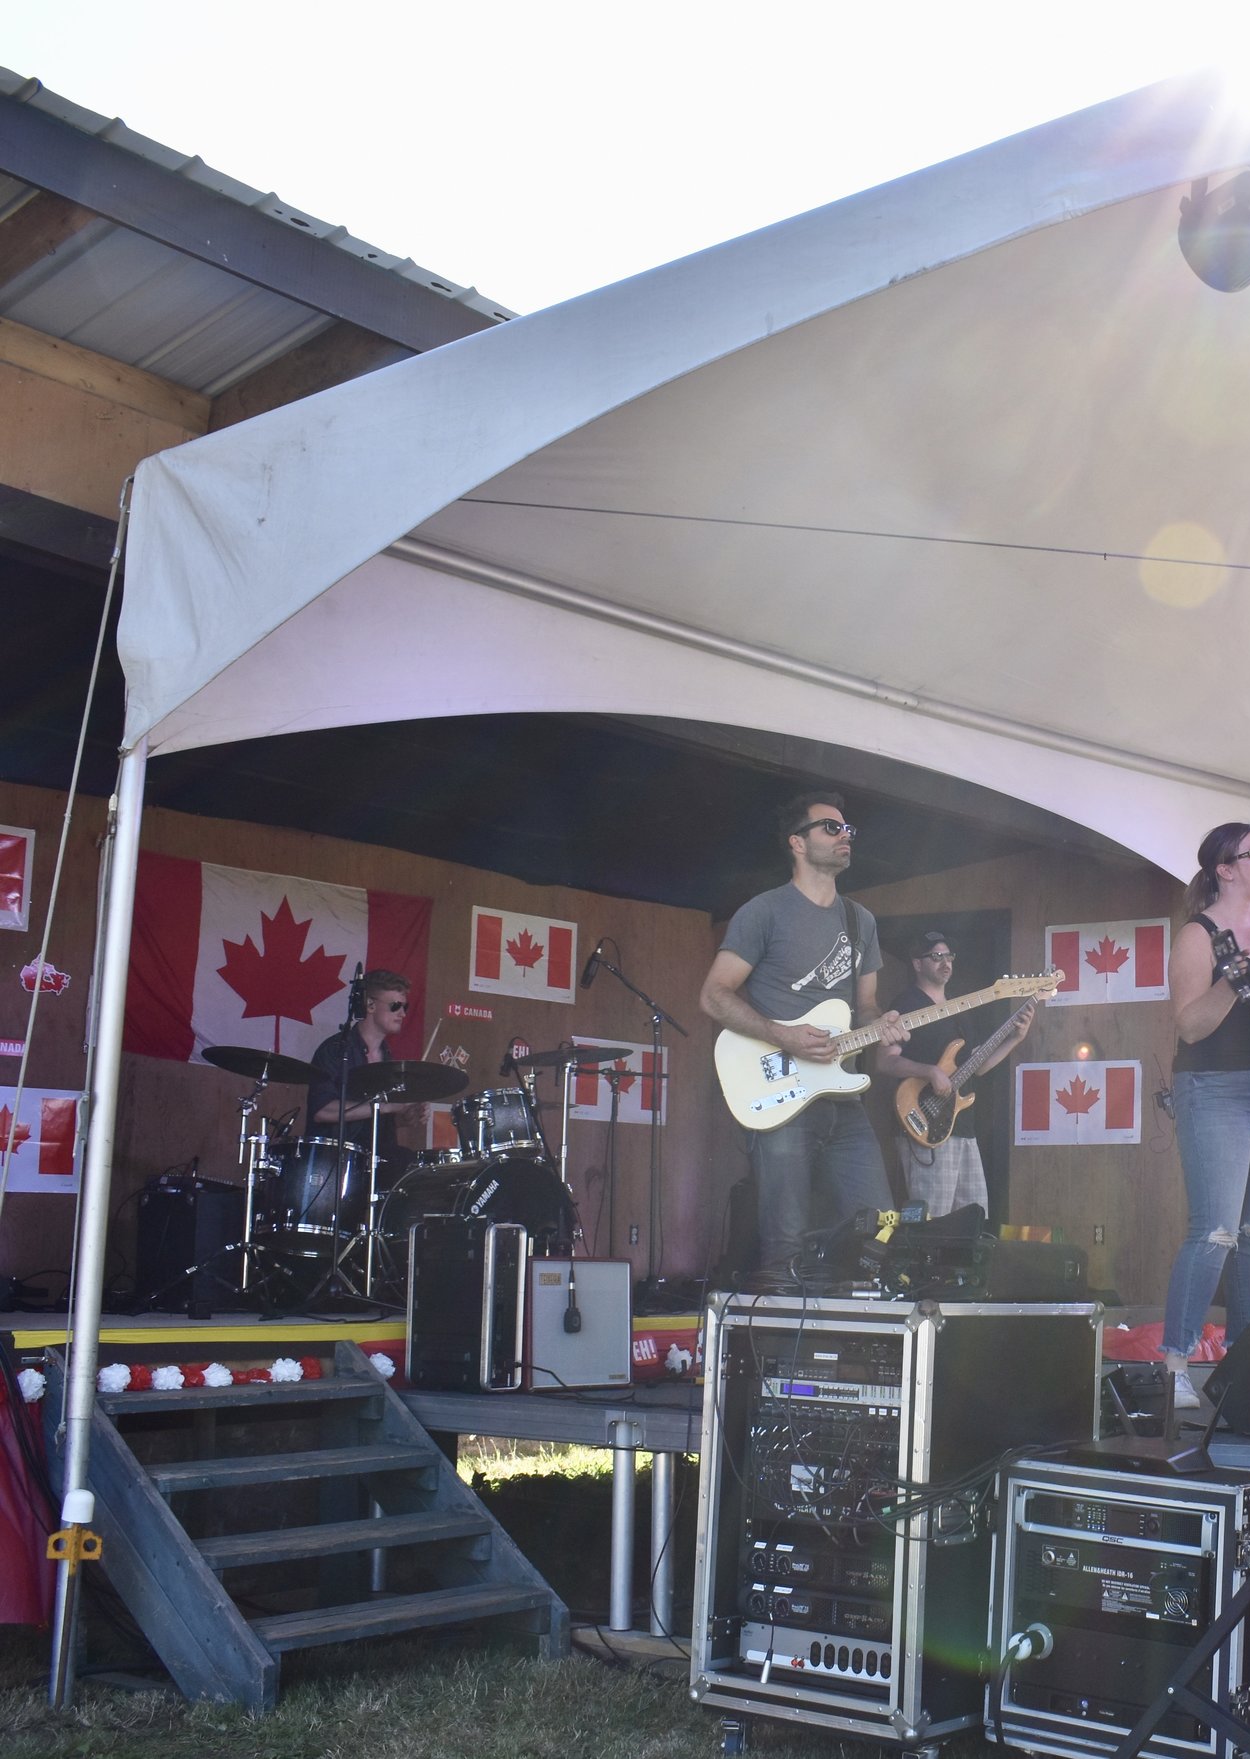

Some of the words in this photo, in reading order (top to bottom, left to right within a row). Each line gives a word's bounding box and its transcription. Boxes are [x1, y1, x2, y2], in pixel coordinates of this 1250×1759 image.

[463, 1007, 493, 1019] CANADA
[475, 1179, 500, 1208] YAMAHA
[632, 1338, 657, 1361] EH!
[1102, 1535, 1124, 1544] QSC
